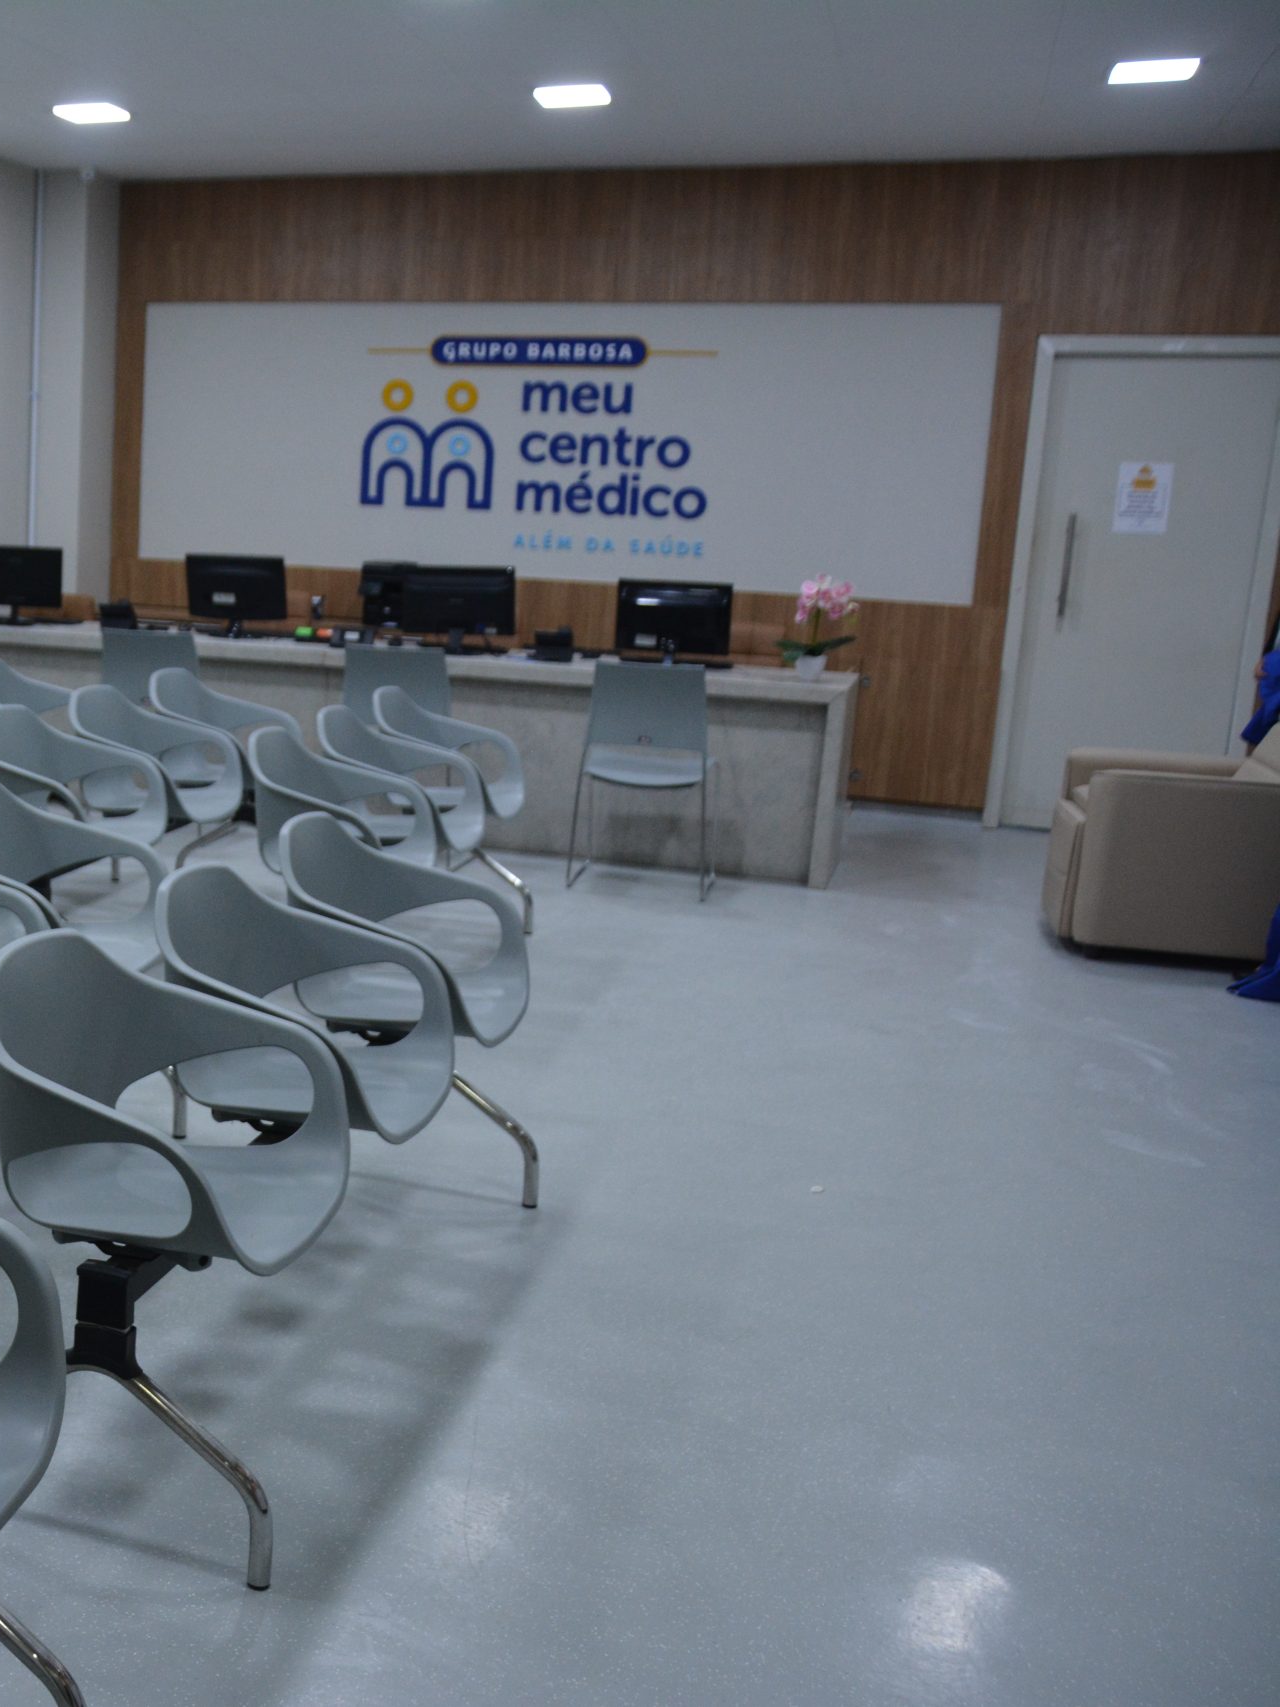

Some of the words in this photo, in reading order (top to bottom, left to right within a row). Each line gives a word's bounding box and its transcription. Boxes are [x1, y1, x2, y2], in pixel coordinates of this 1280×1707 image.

[442, 341, 518, 362] GRUPO
[527, 342, 633, 360] BARBOSA
[521, 380, 633, 414] meu
[520, 427, 691, 468] centro
[516, 471, 707, 519] médico
[514, 530, 572, 551] ALÉM
[586, 535, 615, 552] DA
[630, 534, 704, 556] SAÚDE
